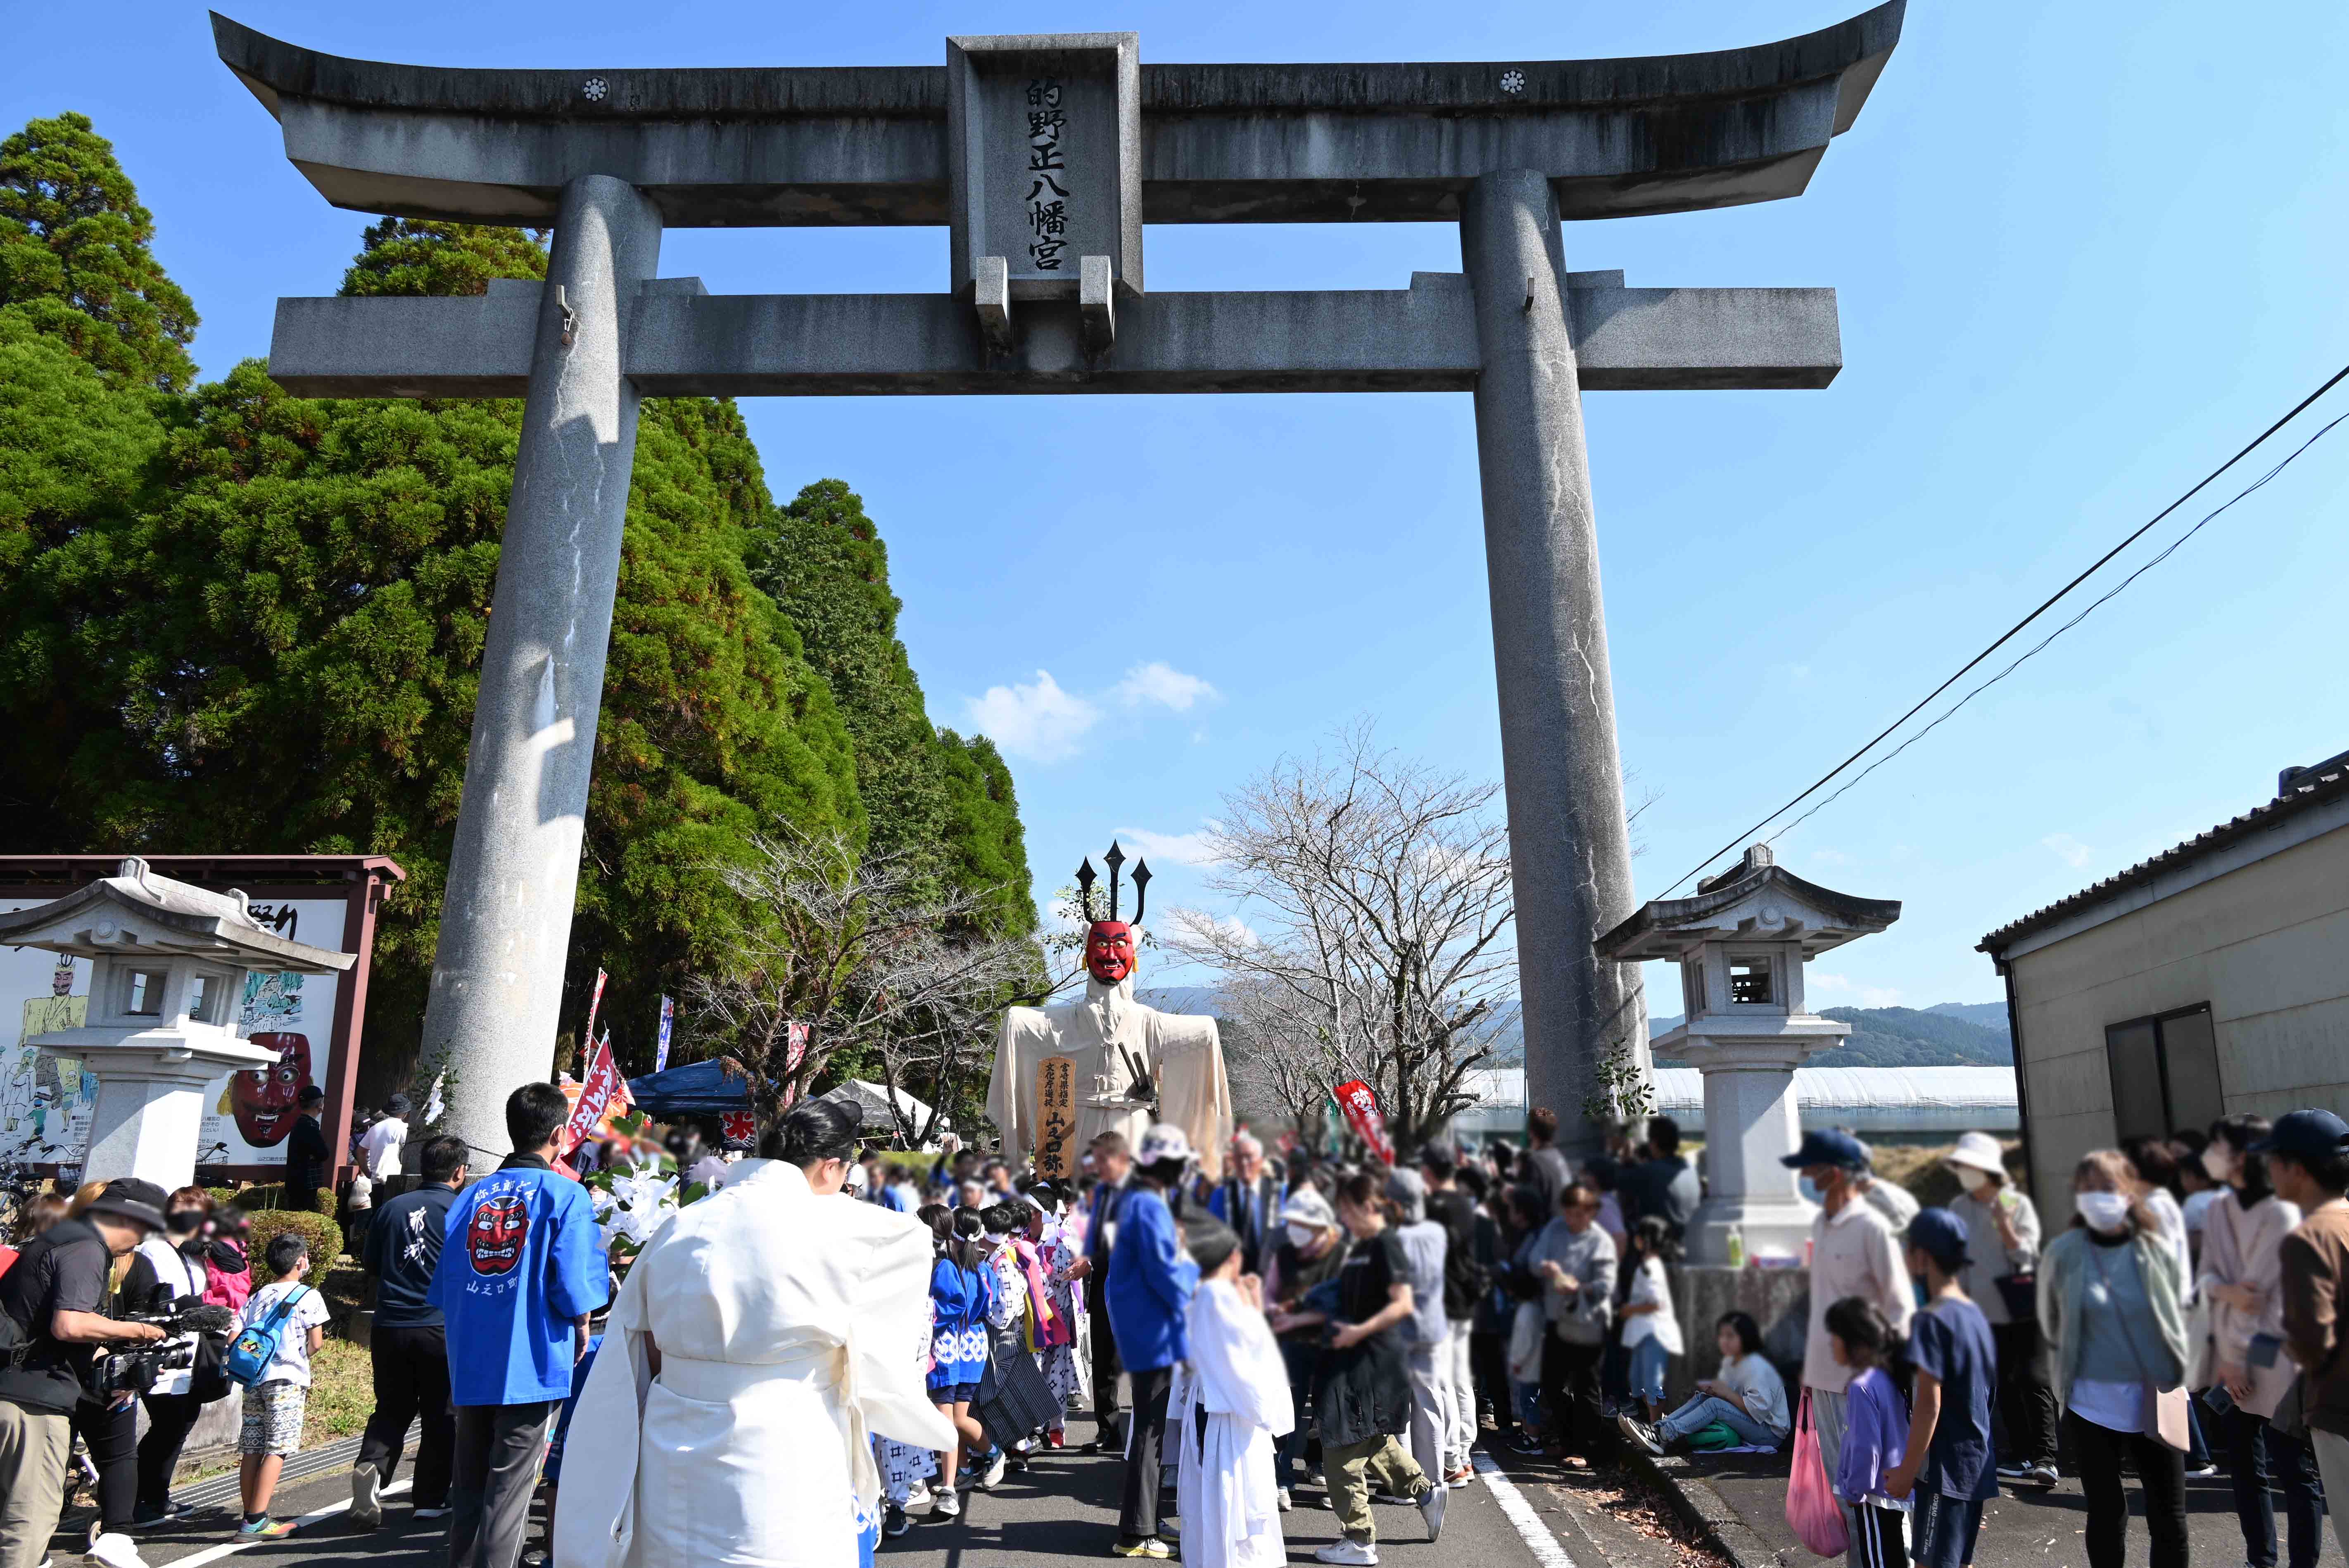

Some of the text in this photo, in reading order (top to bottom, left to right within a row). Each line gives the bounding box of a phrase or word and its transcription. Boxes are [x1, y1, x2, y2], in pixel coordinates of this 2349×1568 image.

[1026, 76, 1070, 270] 的野正八幡宮
[1044, 1063, 1055, 1107] 文化庁選択
[1058, 1063, 1070, 1108] 宮崎県指定
[1043, 1112, 1065, 1177] 山之口弥
[466, 1276, 518, 1295] 山之口町
